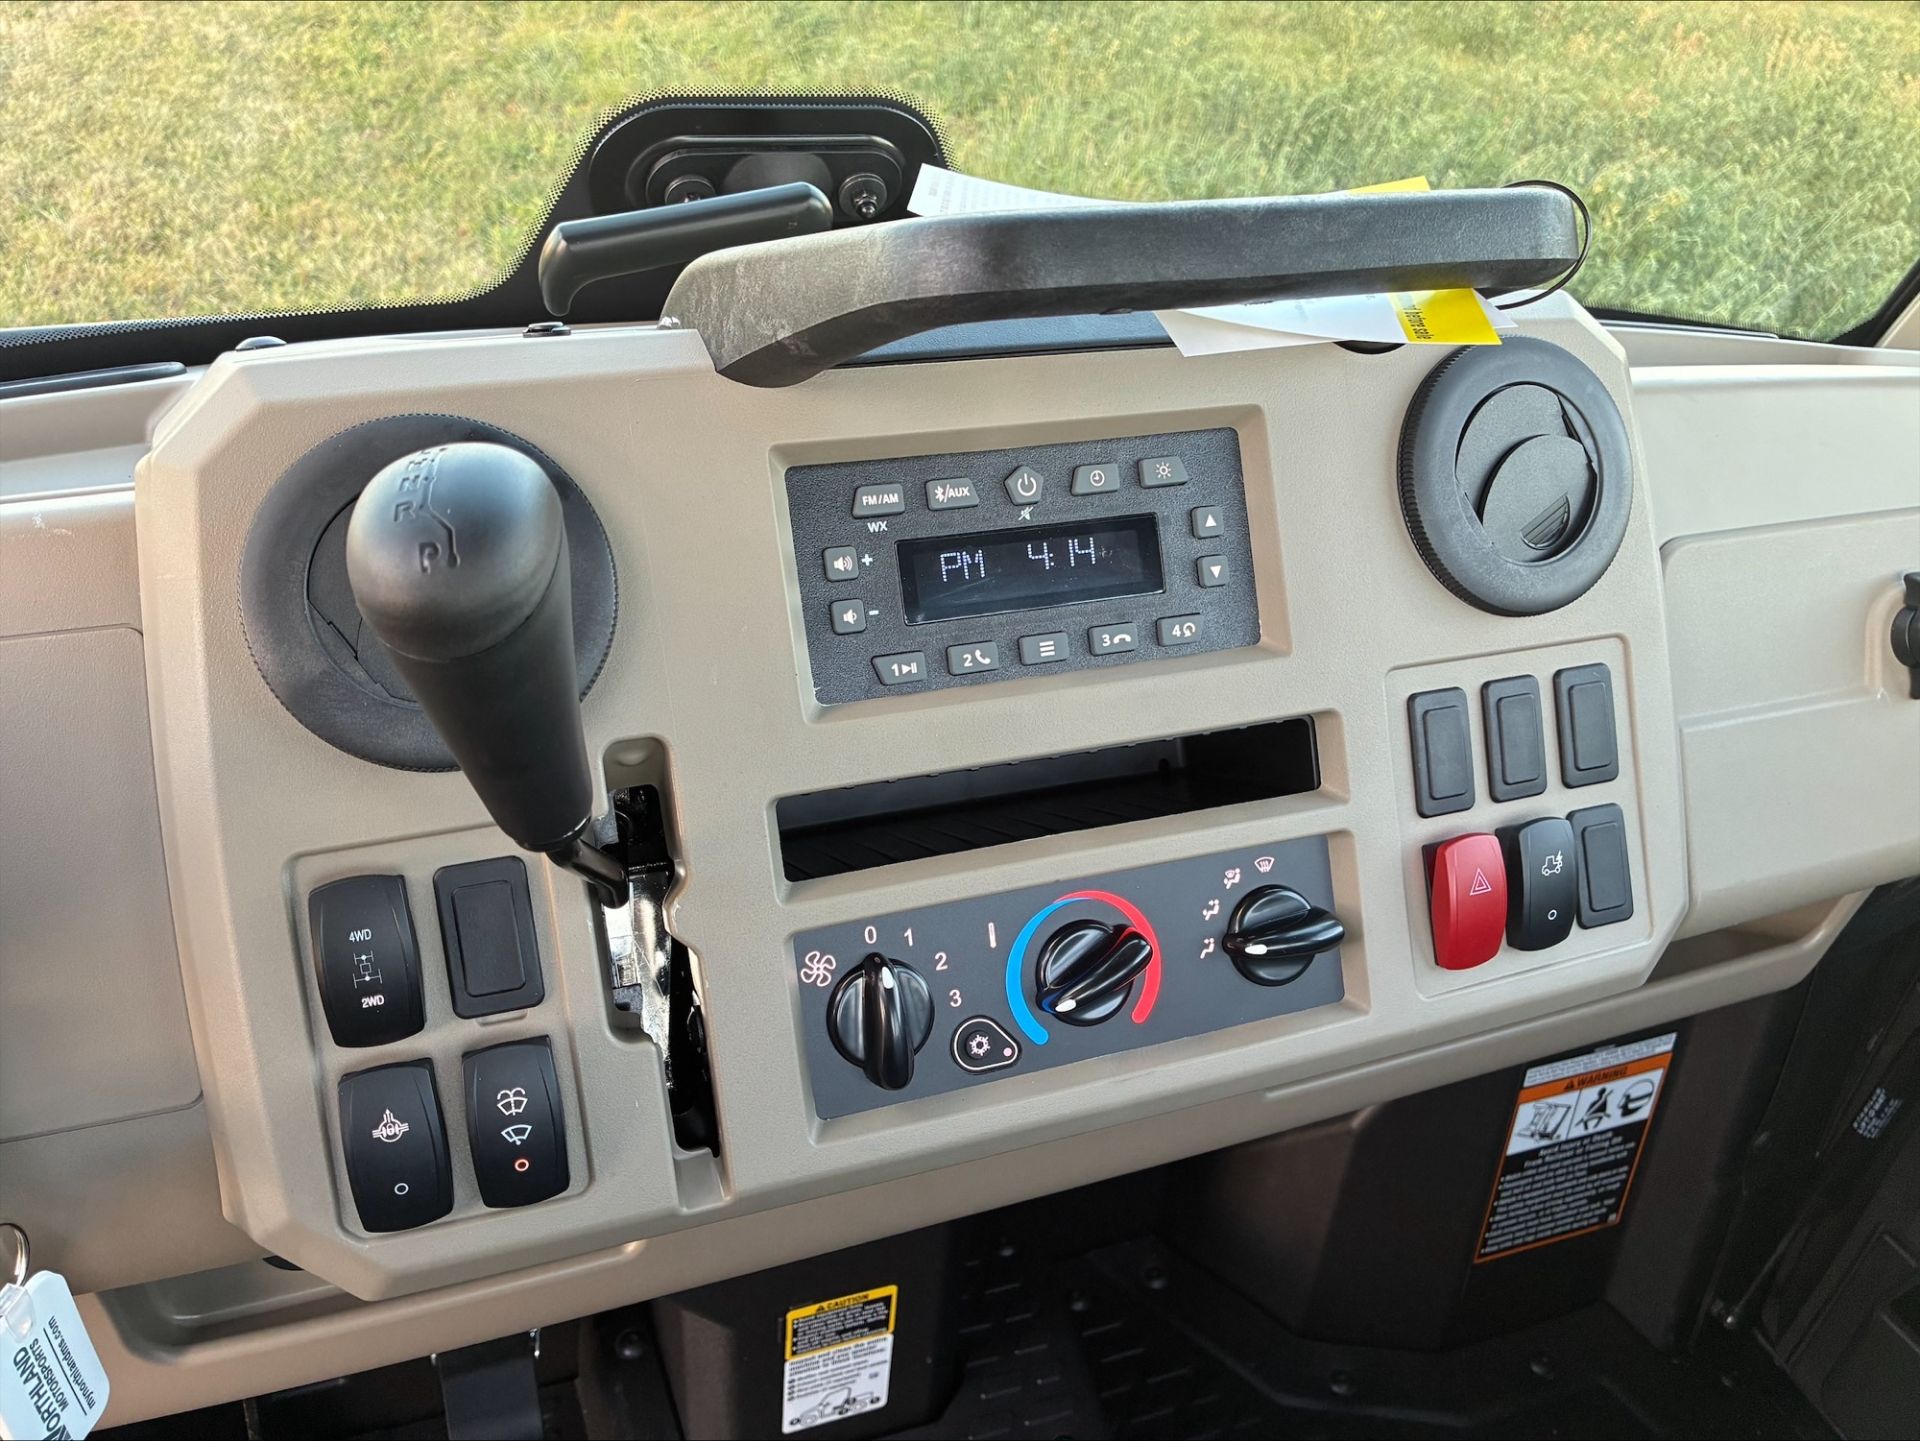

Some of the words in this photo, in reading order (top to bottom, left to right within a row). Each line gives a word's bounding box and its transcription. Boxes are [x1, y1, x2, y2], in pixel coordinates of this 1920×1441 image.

[862, 491, 899, 506] FM/AM
[394, 501, 417, 523] R
[867, 521, 888, 533] WX
[418, 541, 442, 574] P
[939, 548, 986, 583] PM
[1026, 536, 1097, 571] 4:14
[1171, 623, 1183, 638] 4
[1101, 633, 1112, 648] 3
[962, 653, 973, 668] 2
[890, 663, 900, 678] 1
[348, 928, 372, 942] 4WD
[903, 927, 914, 947] 1
[934, 951, 948, 972] 2
[361, 994, 385, 1008] 2WD
[949, 989, 962, 1008] 3
[47, 1315, 97, 1410] mynorthlandms.com
[29, 1337, 70, 1412] MOTORSPORTS
